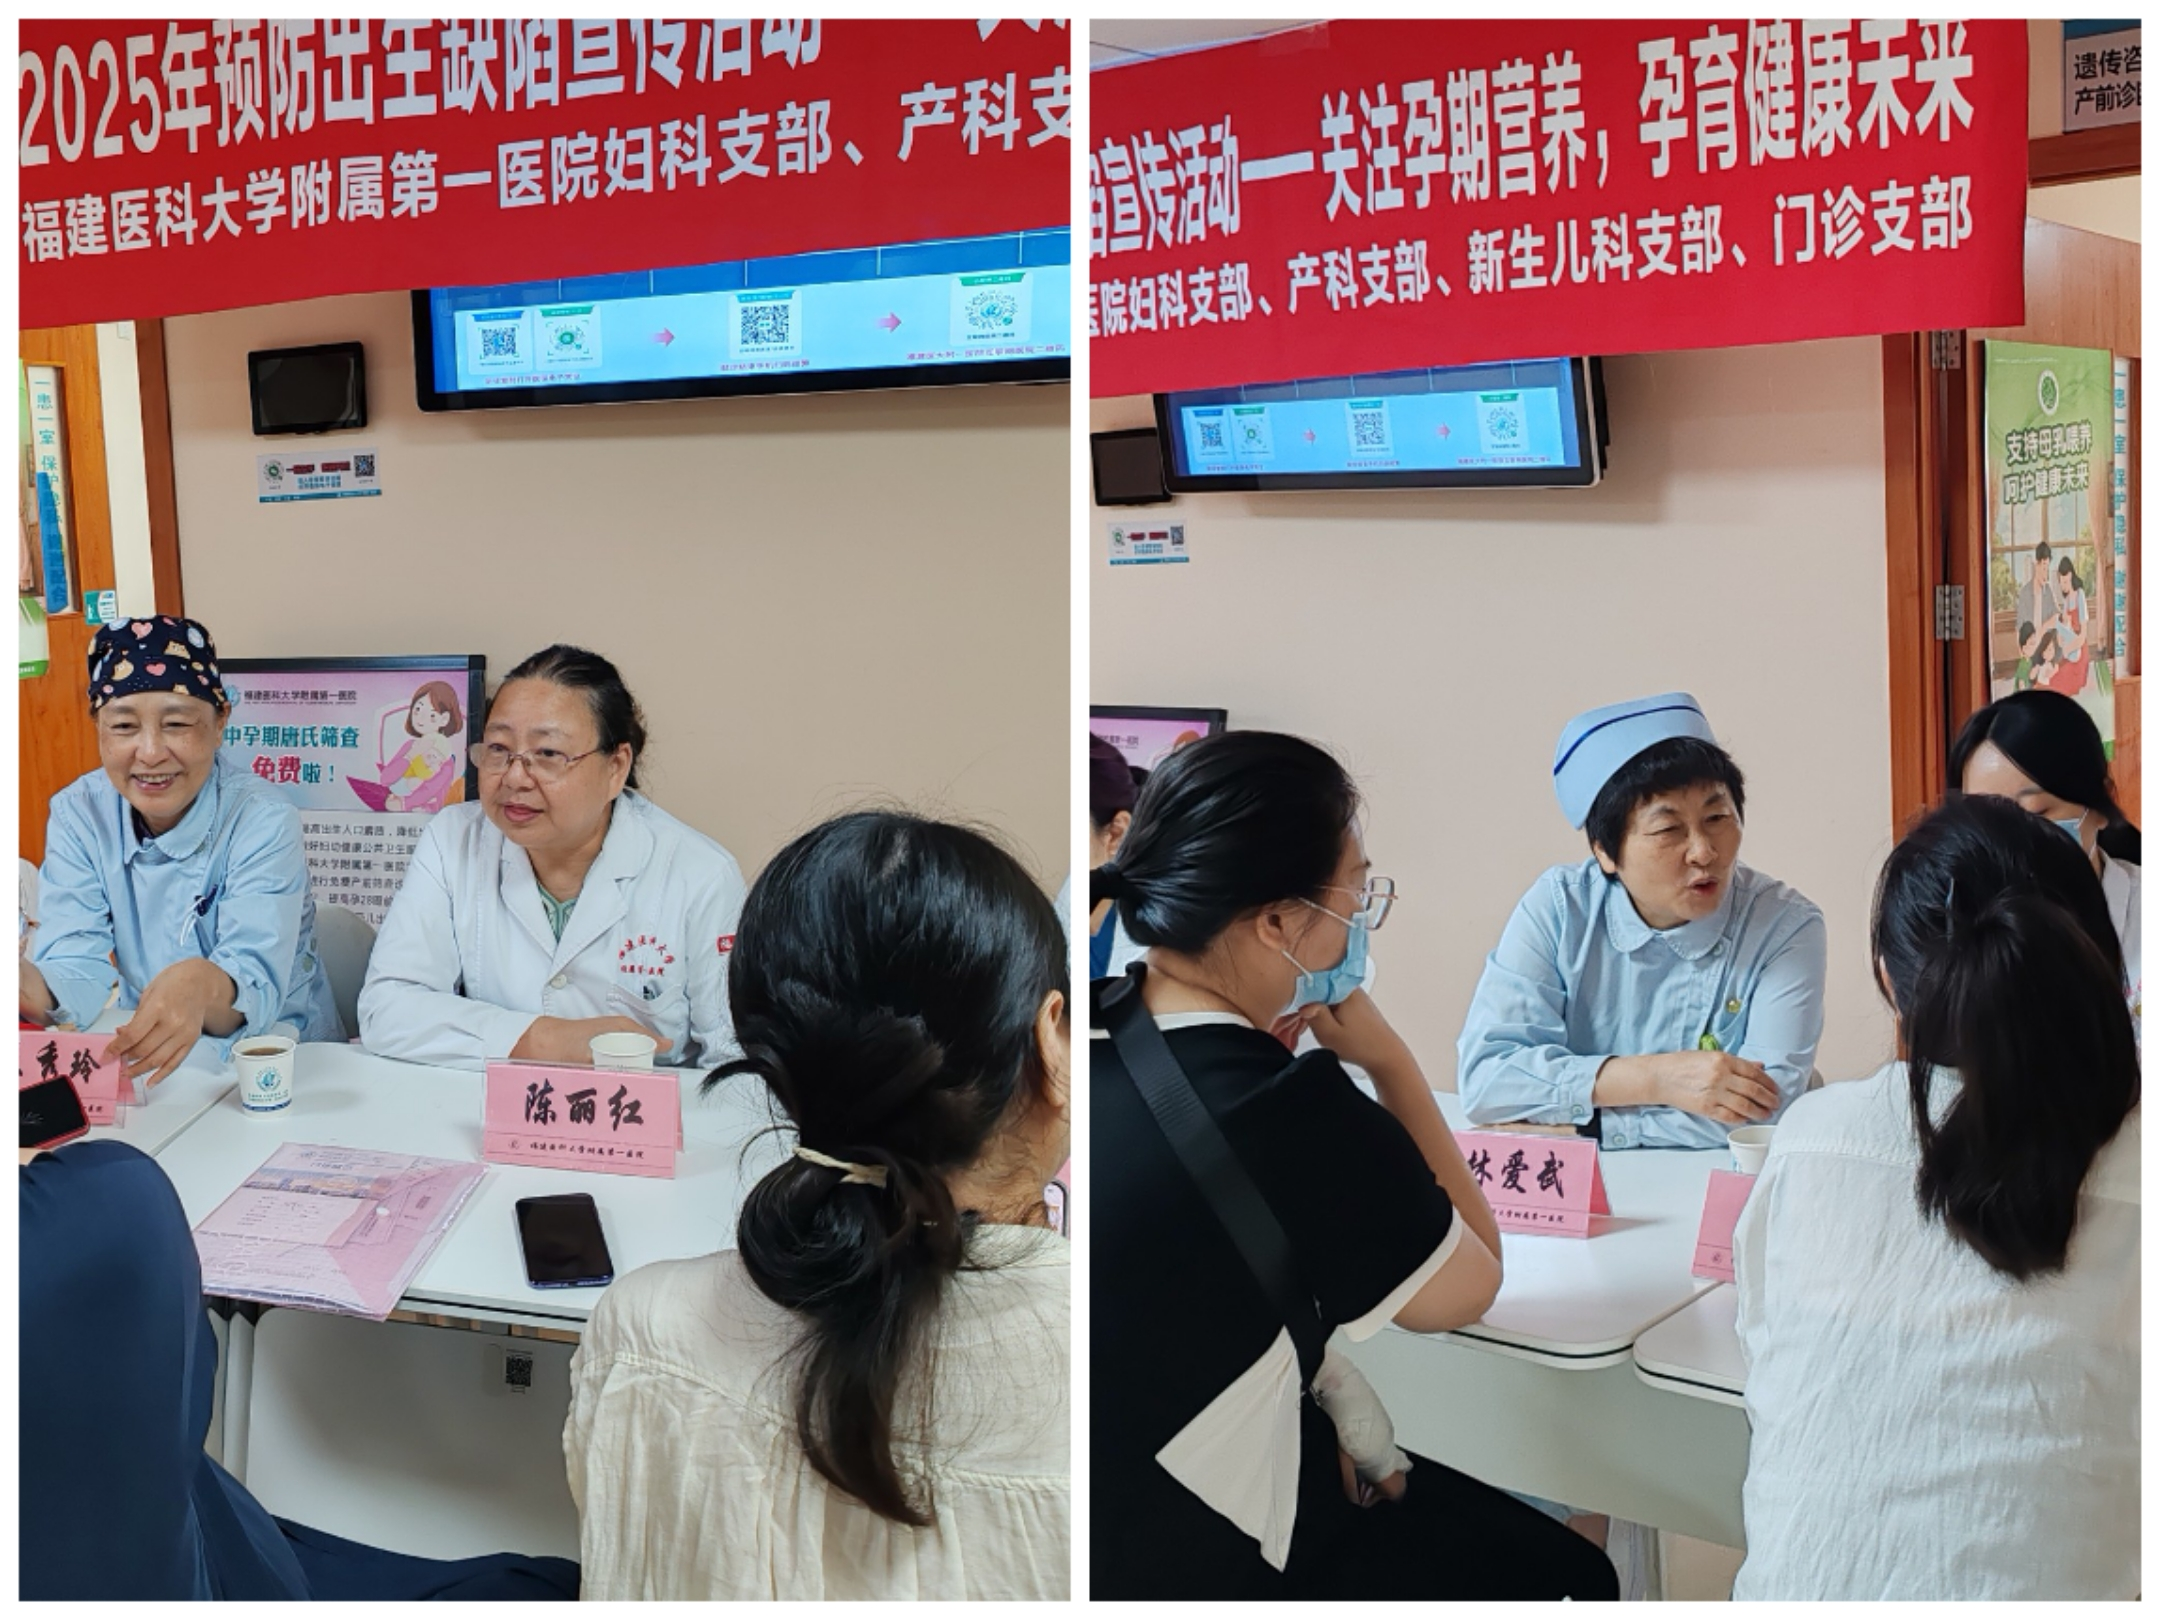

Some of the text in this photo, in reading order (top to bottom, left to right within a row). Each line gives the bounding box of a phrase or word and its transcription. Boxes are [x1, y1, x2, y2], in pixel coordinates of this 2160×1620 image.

[2074, 80, 2141, 115] 产前诊
[2006, 420, 2093, 466] 支持母乳喂养
[2003, 461, 2090, 505] 呵护健康未来
[223, 725, 360, 748] 中孕期唐氏筛查
[19, 1040, 100, 1083] 秀玲
[525, 1077, 644, 1132] 陈丽红
[1467, 1149, 1565, 1199] 林爱武
